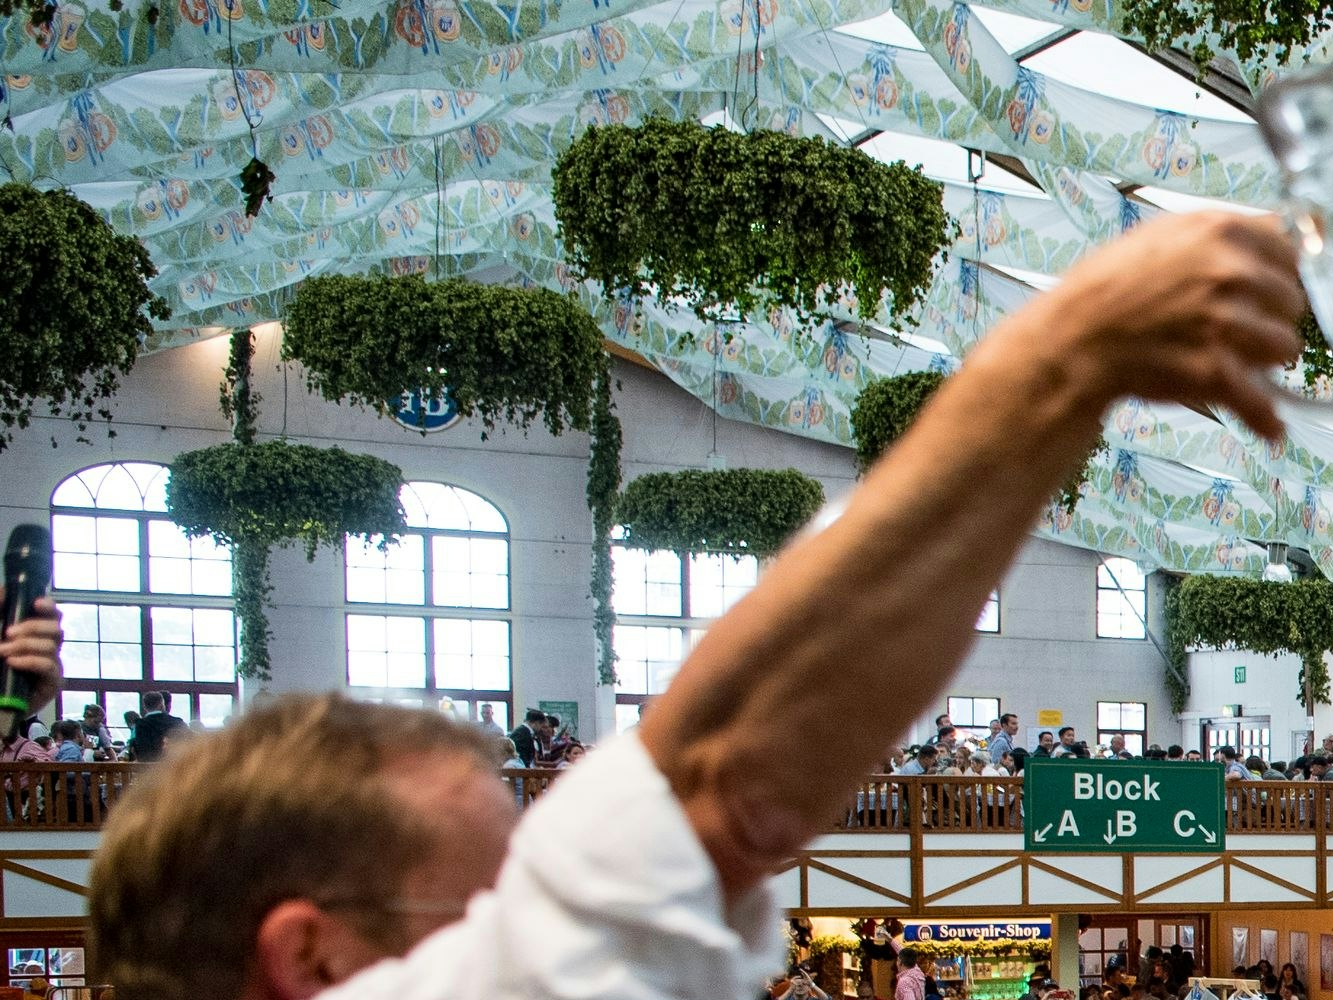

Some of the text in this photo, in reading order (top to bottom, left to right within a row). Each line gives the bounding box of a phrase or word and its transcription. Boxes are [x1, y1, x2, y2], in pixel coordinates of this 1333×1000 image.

[1074, 772, 1161, 801] Block
[1057, 809, 1196, 838] A B C
[940, 925, 1041, 939] Souvenir-Shop
